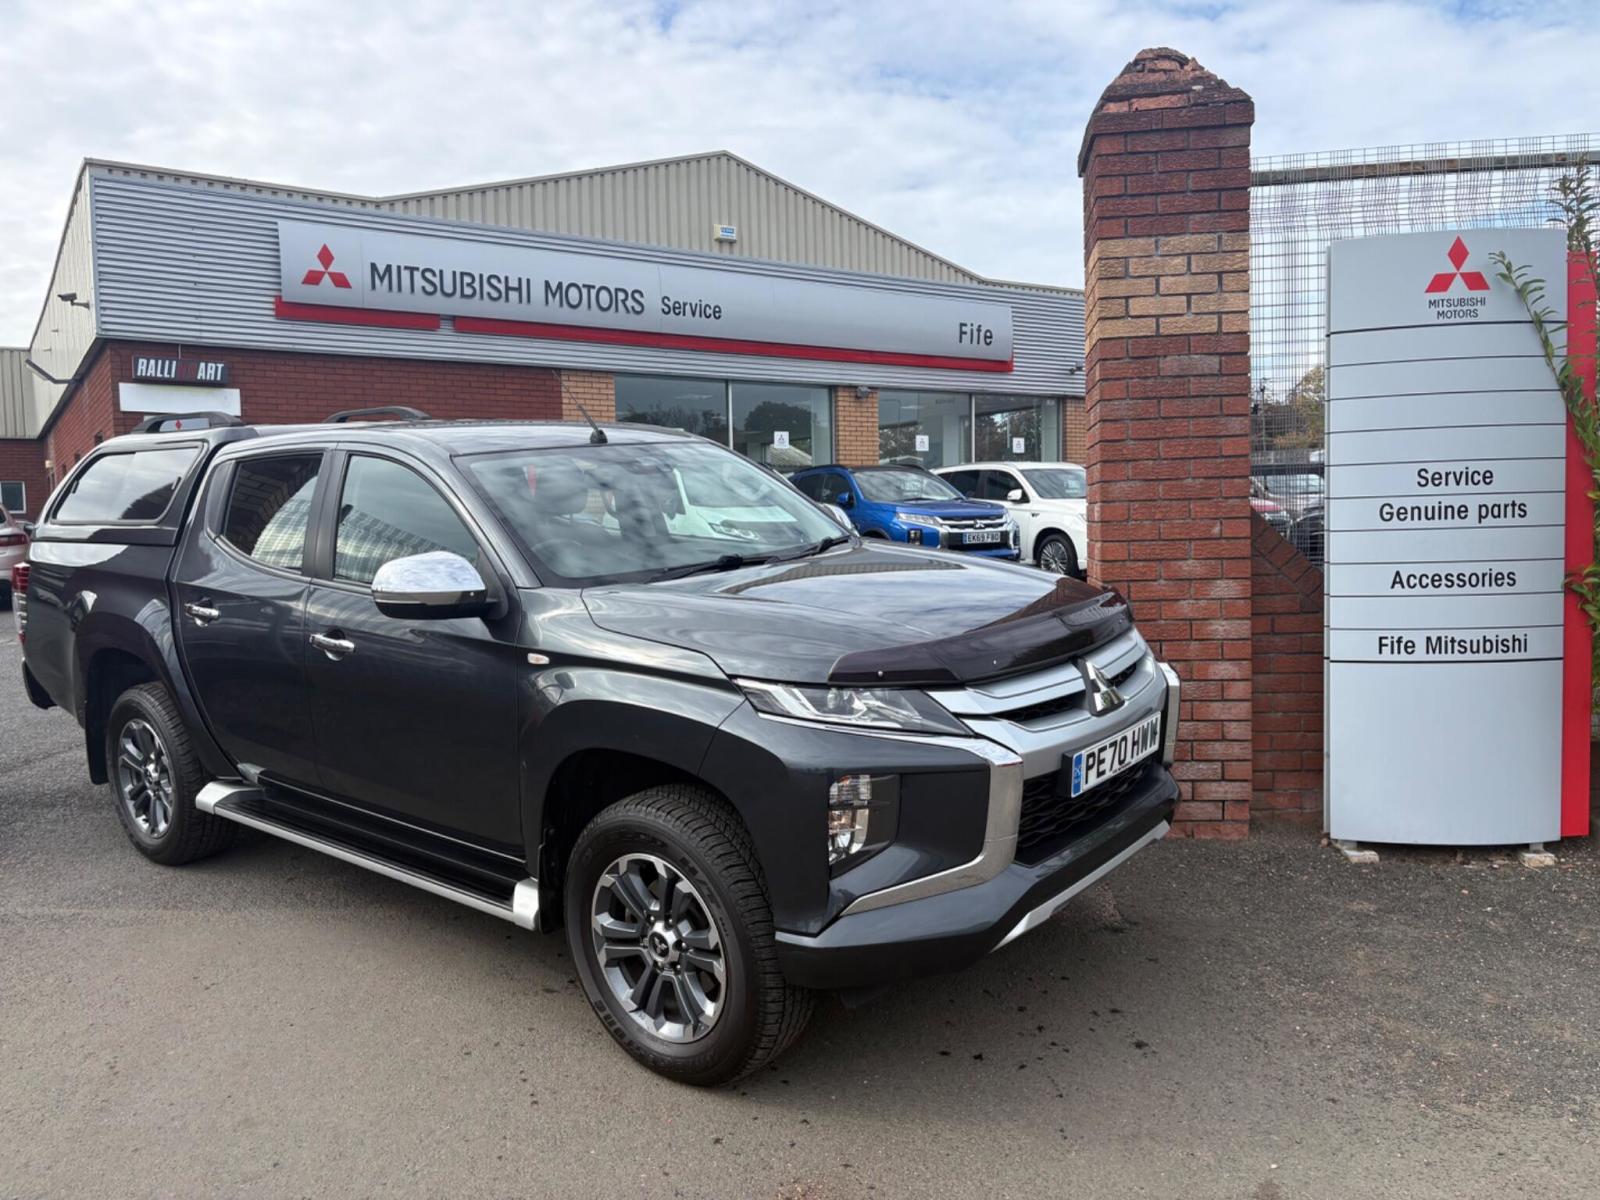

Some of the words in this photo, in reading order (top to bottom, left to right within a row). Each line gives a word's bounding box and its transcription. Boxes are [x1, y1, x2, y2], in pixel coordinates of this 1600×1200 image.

[369, 261, 532, 305] MITSUBISHI
[544, 280, 646, 316] MOTORS
[660, 295, 723, 321] Service
[1428, 297, 1486, 309] MITSUBISHI
[1436, 308, 1479, 320] MOTORS
[957, 321, 994, 347] Fife
[137, 358, 177, 378] RALLI
[197, 362, 224, 381] ART
[1416, 466, 1494, 488] Service
[1378, 500, 1469, 522] Genuine
[1477, 499, 1528, 524] parts
[1390, 567, 1517, 590] Accessories
[1378, 635, 1416, 656] Fife
[1425, 632, 1528, 656] Mitsubishi
[1085, 735, 1128, 785] PE70
[1131, 716, 1158, 760] HWW
